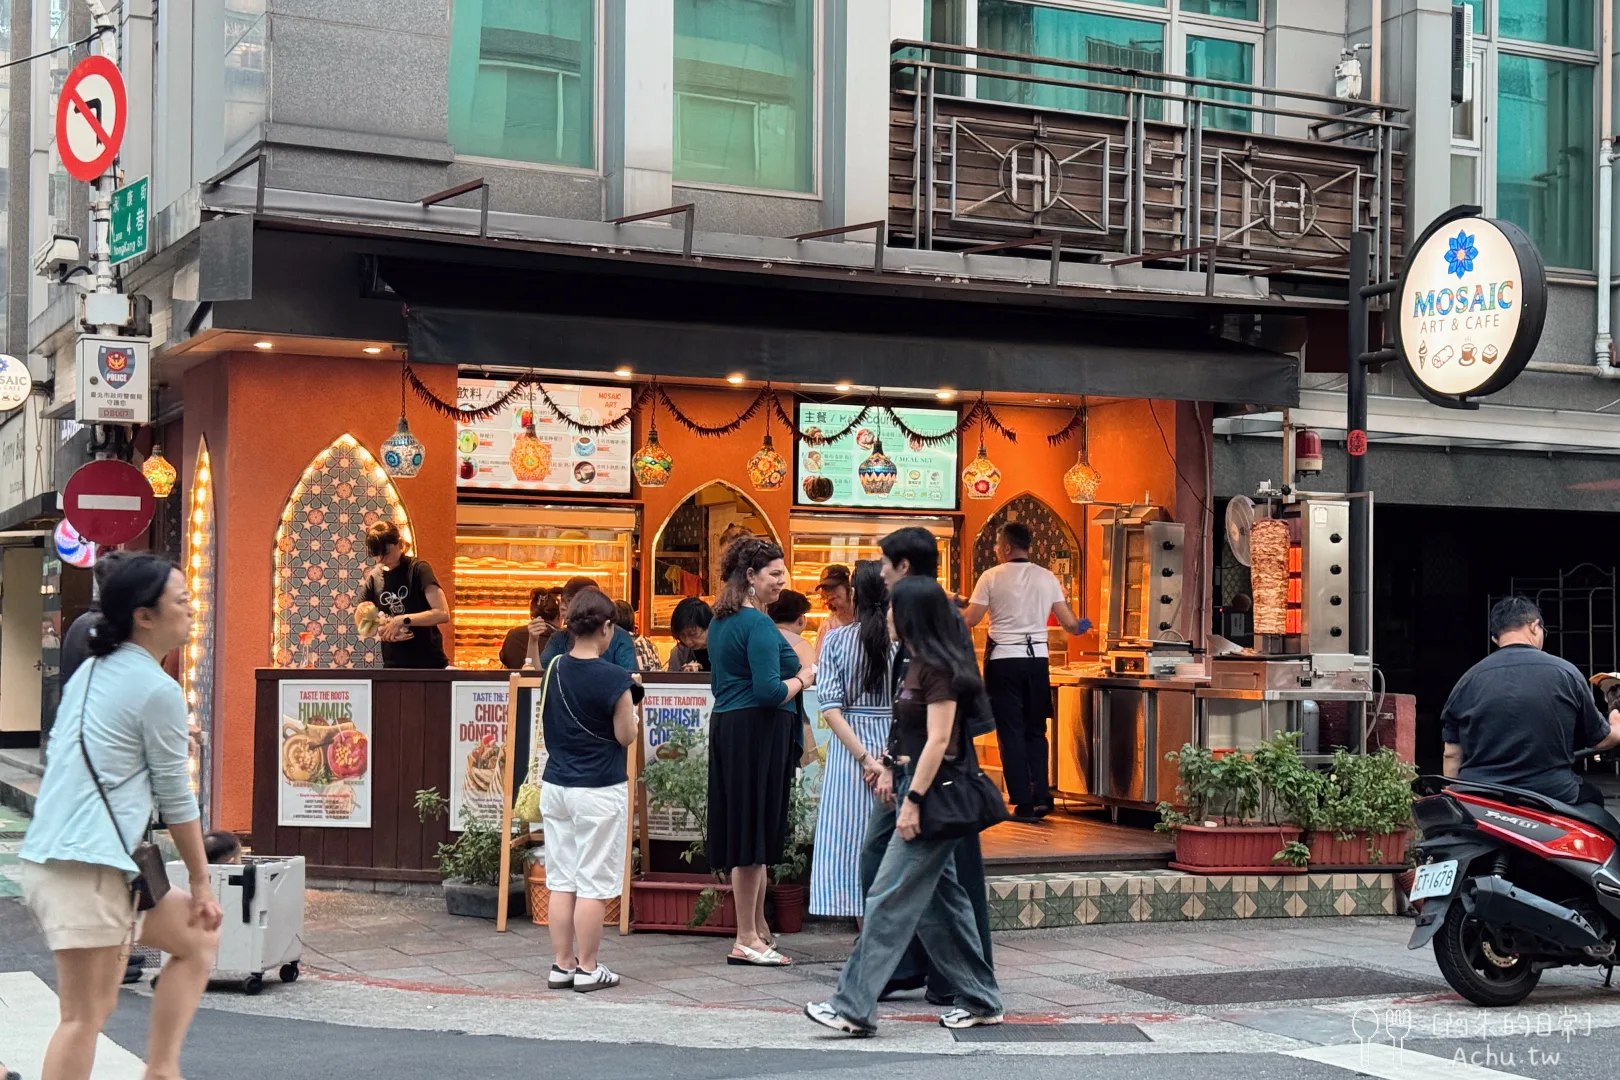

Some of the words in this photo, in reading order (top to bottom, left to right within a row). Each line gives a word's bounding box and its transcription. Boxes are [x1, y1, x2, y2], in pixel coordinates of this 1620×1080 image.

[113, 183, 147, 213] 永康街
[1413, 280, 1514, 318] MOSAIC
[1420, 319, 1445, 334] ART
[1451, 317, 1459, 331] &
[1465, 314, 1500, 330] CAFE
[106, 373, 127, 382] POLICE
[457, 386, 482, 400] 飲料
[598, 392, 622, 400] MOSAIC
[804, 411, 827, 424] 主餐
[300, 691, 318, 700] TASTE
[319, 691, 330, 700] THE
[331, 691, 349, 700] ROOTS
[473, 692, 492, 702] TASTE
[493, 692, 504, 702] THE
[643, 696, 660, 706] ASTE
[661, 696, 673, 706] THE
[674, 696, 707, 706] TRADITION
[298, 702, 353, 720] HUMMUS
[645, 708, 700, 727] TURKISH
[459, 721, 499, 742] DÖNER
[1413, 869, 1454, 892] CT-1678
